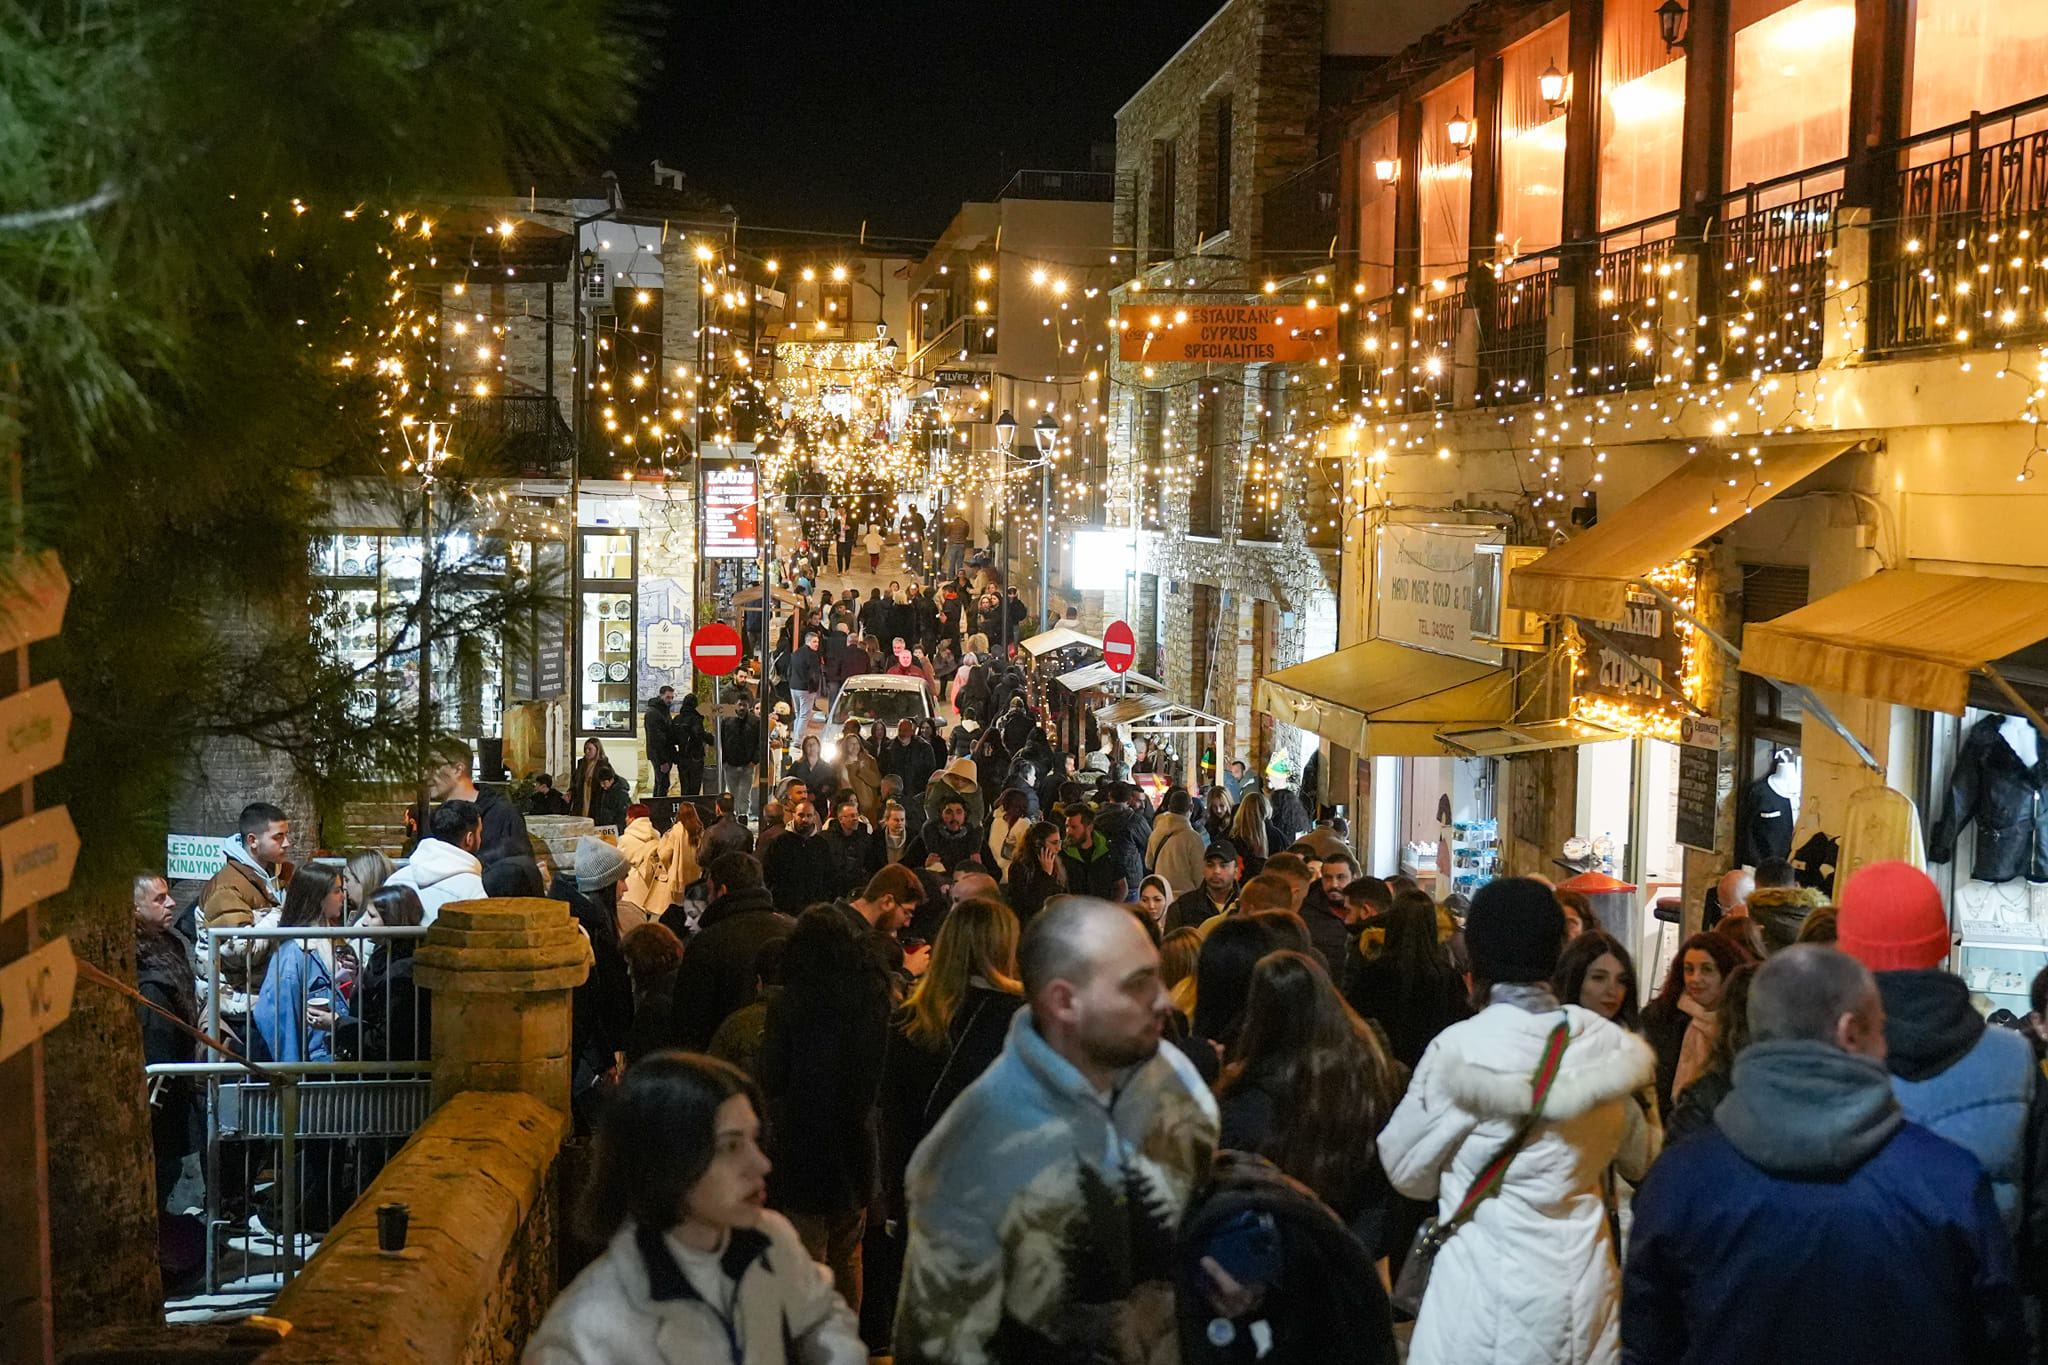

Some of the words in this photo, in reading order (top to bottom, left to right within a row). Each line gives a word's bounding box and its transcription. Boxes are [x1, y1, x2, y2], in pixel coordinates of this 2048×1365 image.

[1184, 308, 1277, 324] ESTAURANT
[1201, 326, 1257, 341] CYPRUS
[1184, 343, 1274, 359] SPECIALITIES
[1391, 576, 1409, 600] HAND
[1411, 578, 1430, 604] MADE
[1432, 581, 1451, 607] GOLD
[172, 842, 220, 857] ΕΞΟΔΟΣ
